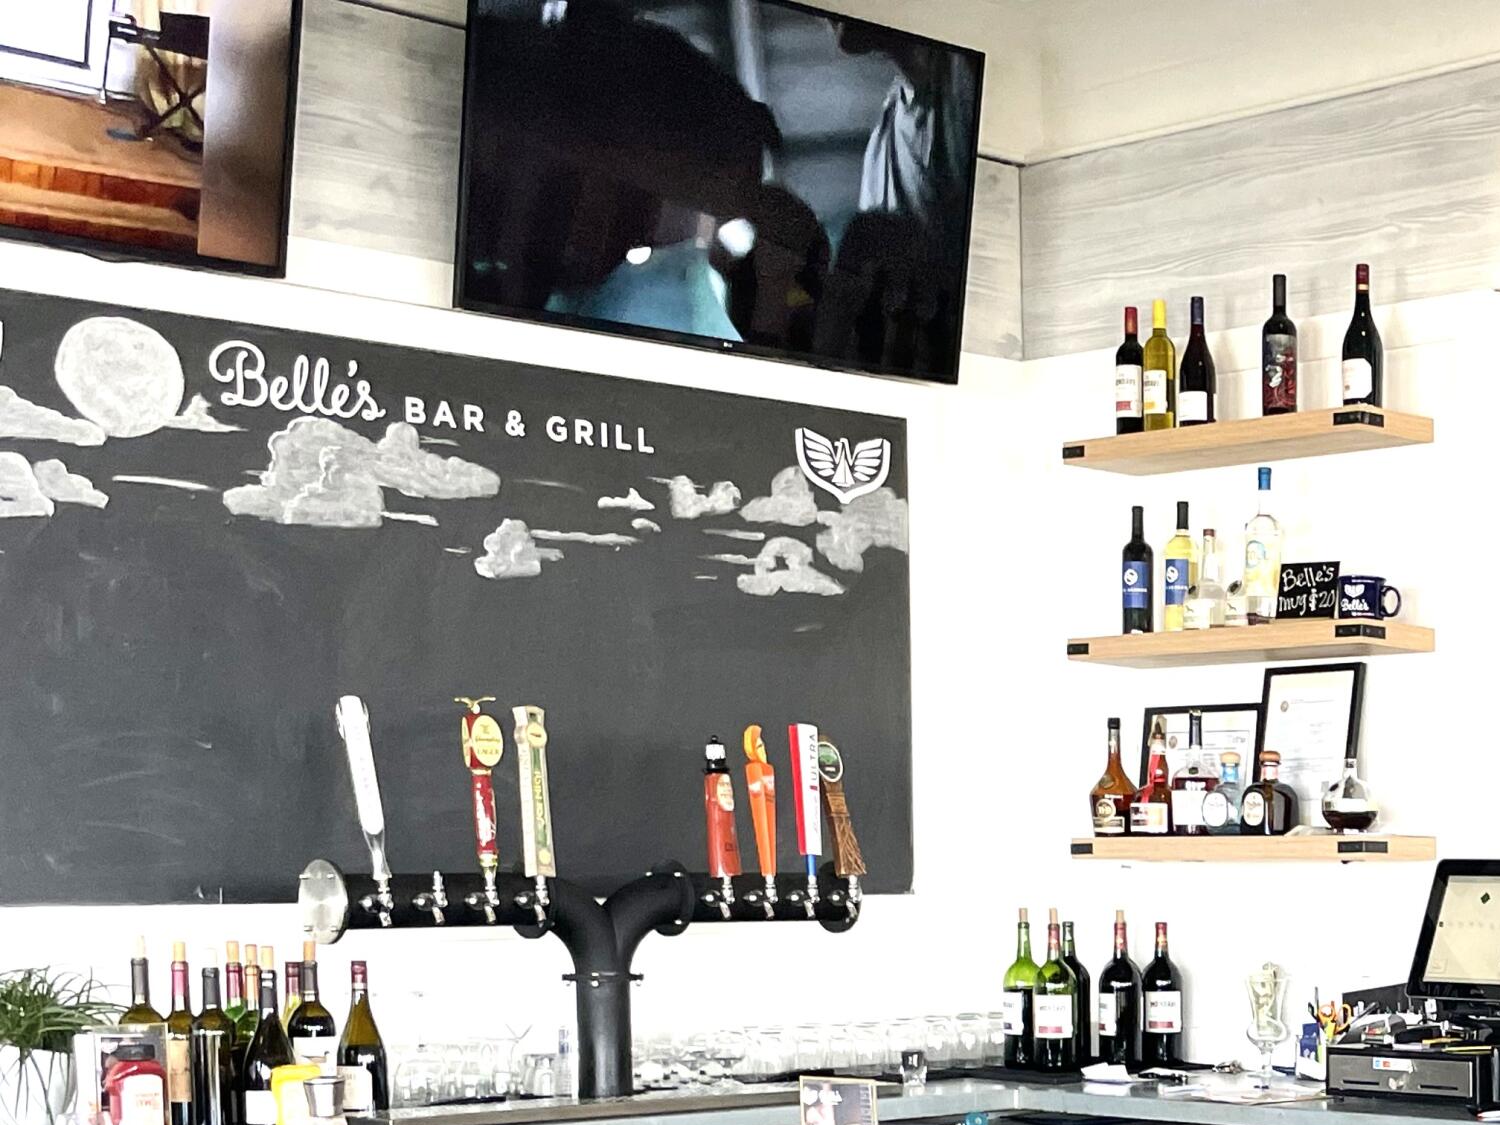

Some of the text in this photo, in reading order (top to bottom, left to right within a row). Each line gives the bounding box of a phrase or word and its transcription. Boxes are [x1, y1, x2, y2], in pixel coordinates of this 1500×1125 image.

[208, 339, 656, 455] Belle's BAR & GRILL
[1281, 565, 1335, 592] Belle's
[1279, 588, 1336, 615] mug $20
[809, 733, 819, 783] ULTRA
